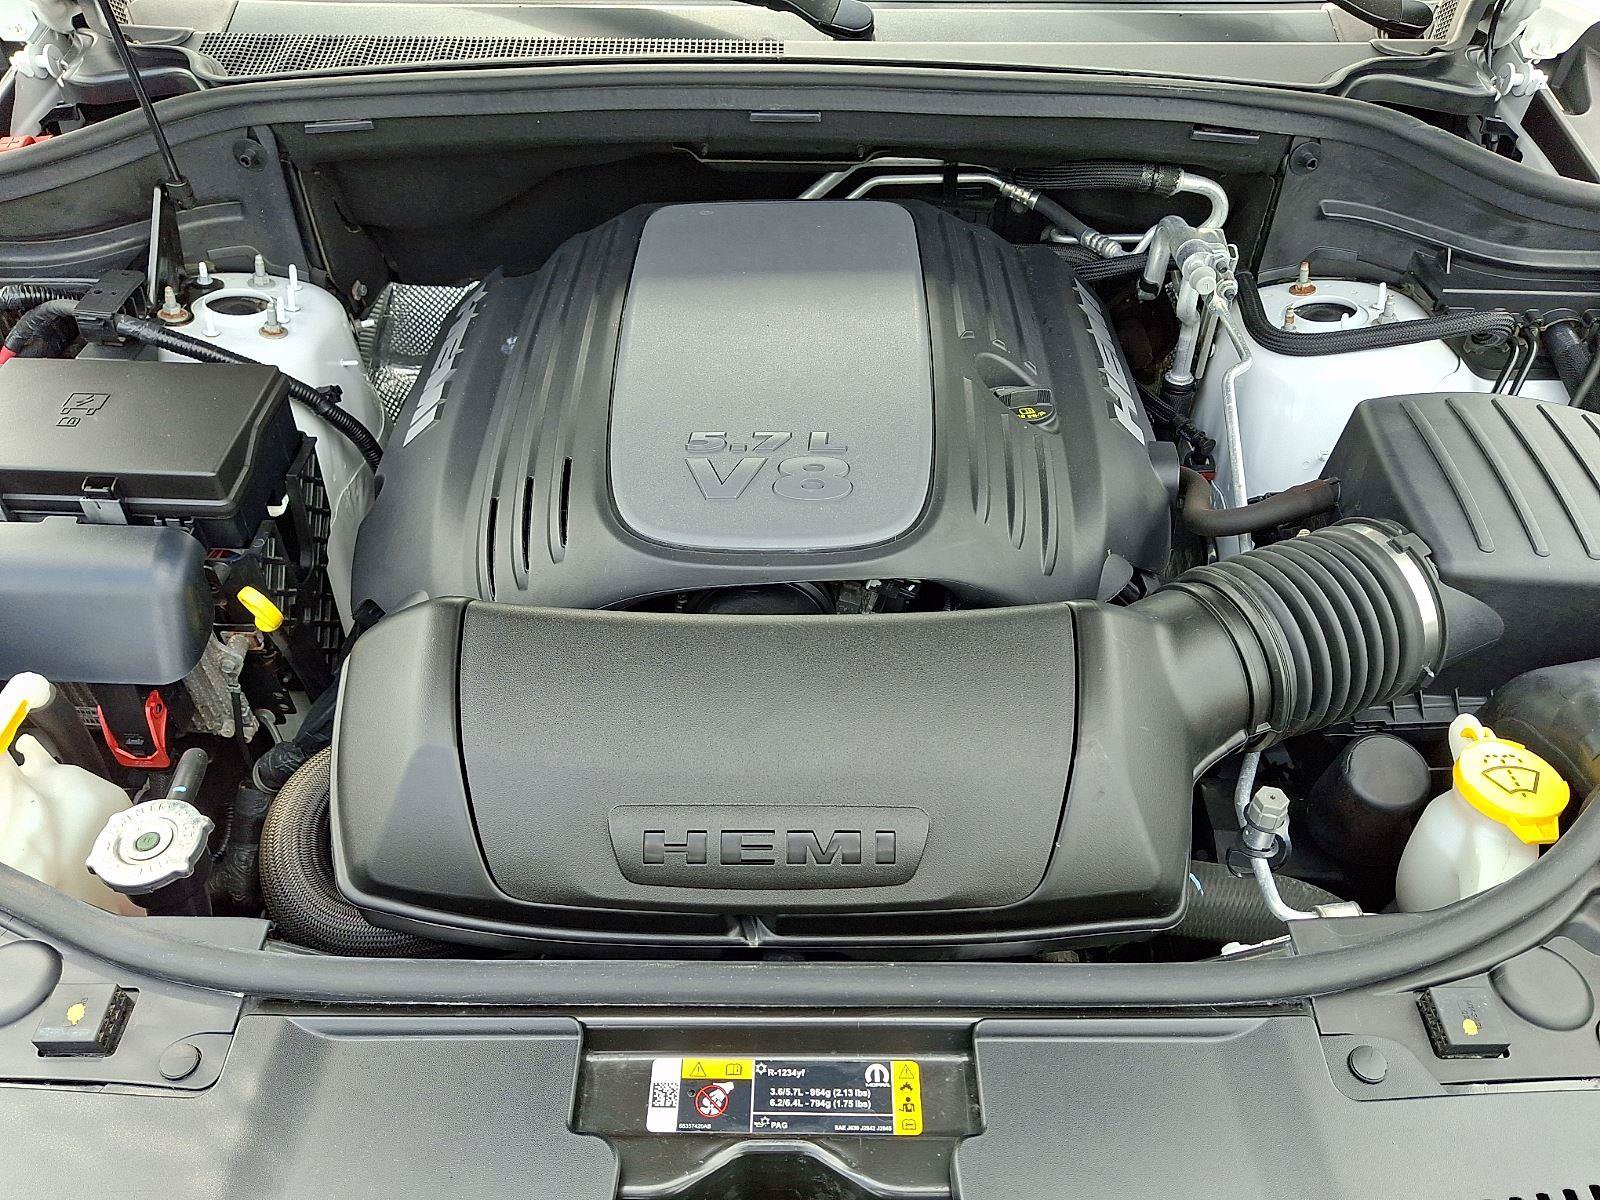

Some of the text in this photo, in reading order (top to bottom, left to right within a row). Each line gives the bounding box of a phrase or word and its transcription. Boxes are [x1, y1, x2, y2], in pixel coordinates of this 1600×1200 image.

[685, 431, 848, 452] 5.7 L
[684, 456, 854, 500] V8
[643, 830, 896, 865] HEMI
[767, 1068, 806, 1078] R-1234yf
[769, 1088, 804, 1097] 3.6/5.7L
[833, 1088, 853, 1098] (2.13
[855, 1088, 871, 1099] lbs)
[769, 1099, 803, 1108] 6.2/6.4L
[833, 1100, 853, 1109] (1.75
[855, 1100, 872, 1109] lbs)
[770, 1121, 788, 1129] PAG
